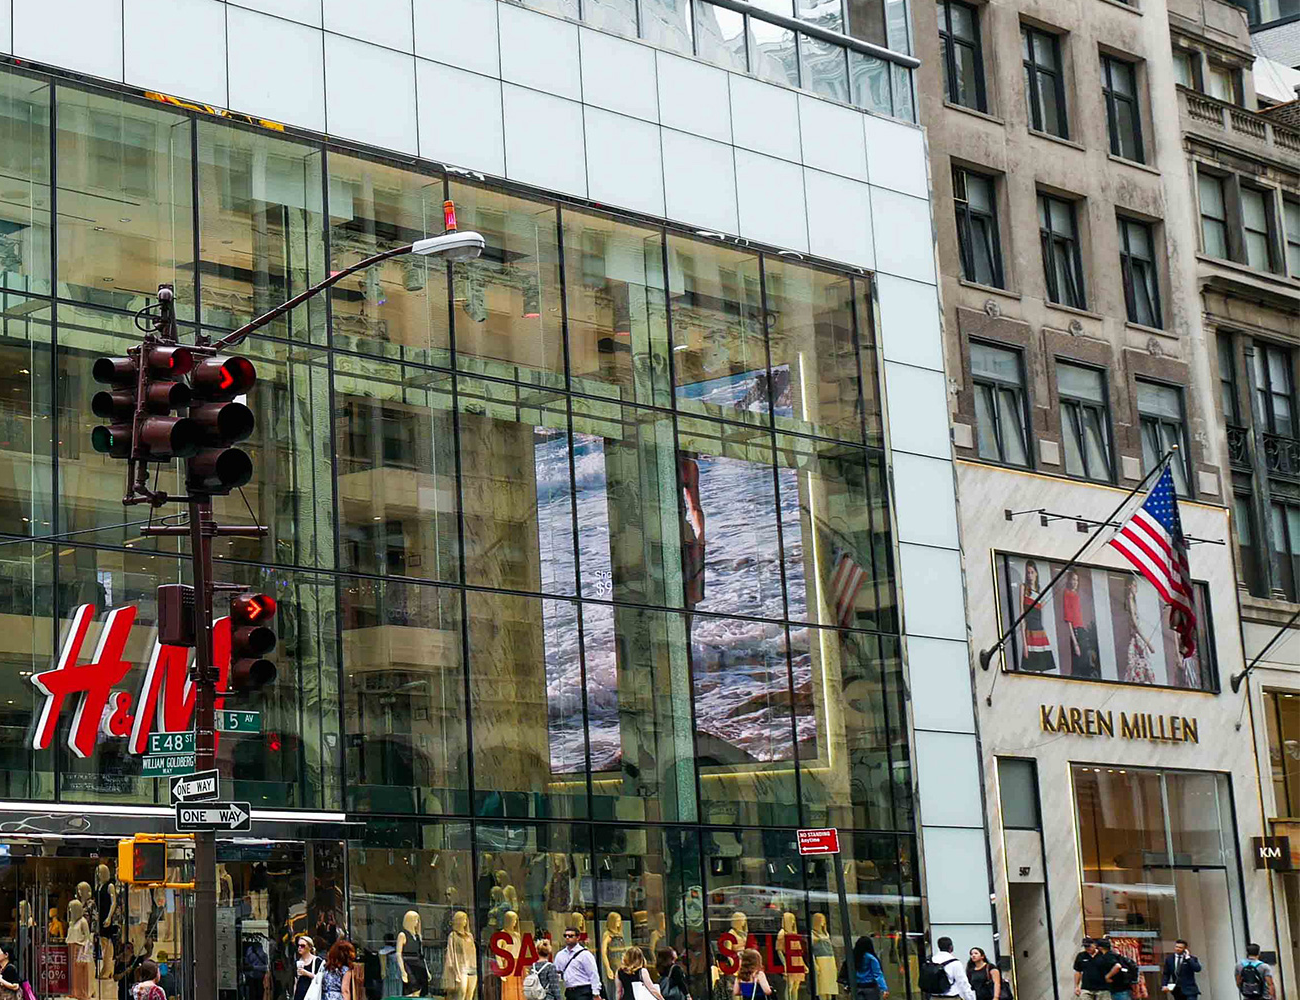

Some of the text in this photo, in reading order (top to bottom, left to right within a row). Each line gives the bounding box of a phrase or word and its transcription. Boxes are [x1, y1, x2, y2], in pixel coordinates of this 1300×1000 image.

[30, 603, 232, 759] H&M
[229, 713, 254, 729] 5 AV
[1040, 704, 1199, 744] KAREN MILLEN
[152, 734, 193, 752] E 48 ST
[142, 756, 194, 770] WILLIAM GOLDBERG
[176, 780, 212, 796] ONE WAY
[182, 811, 241, 822] ONE WAY
[1259, 847, 1282, 858] KM
[41, 970, 66, 980] 60%
